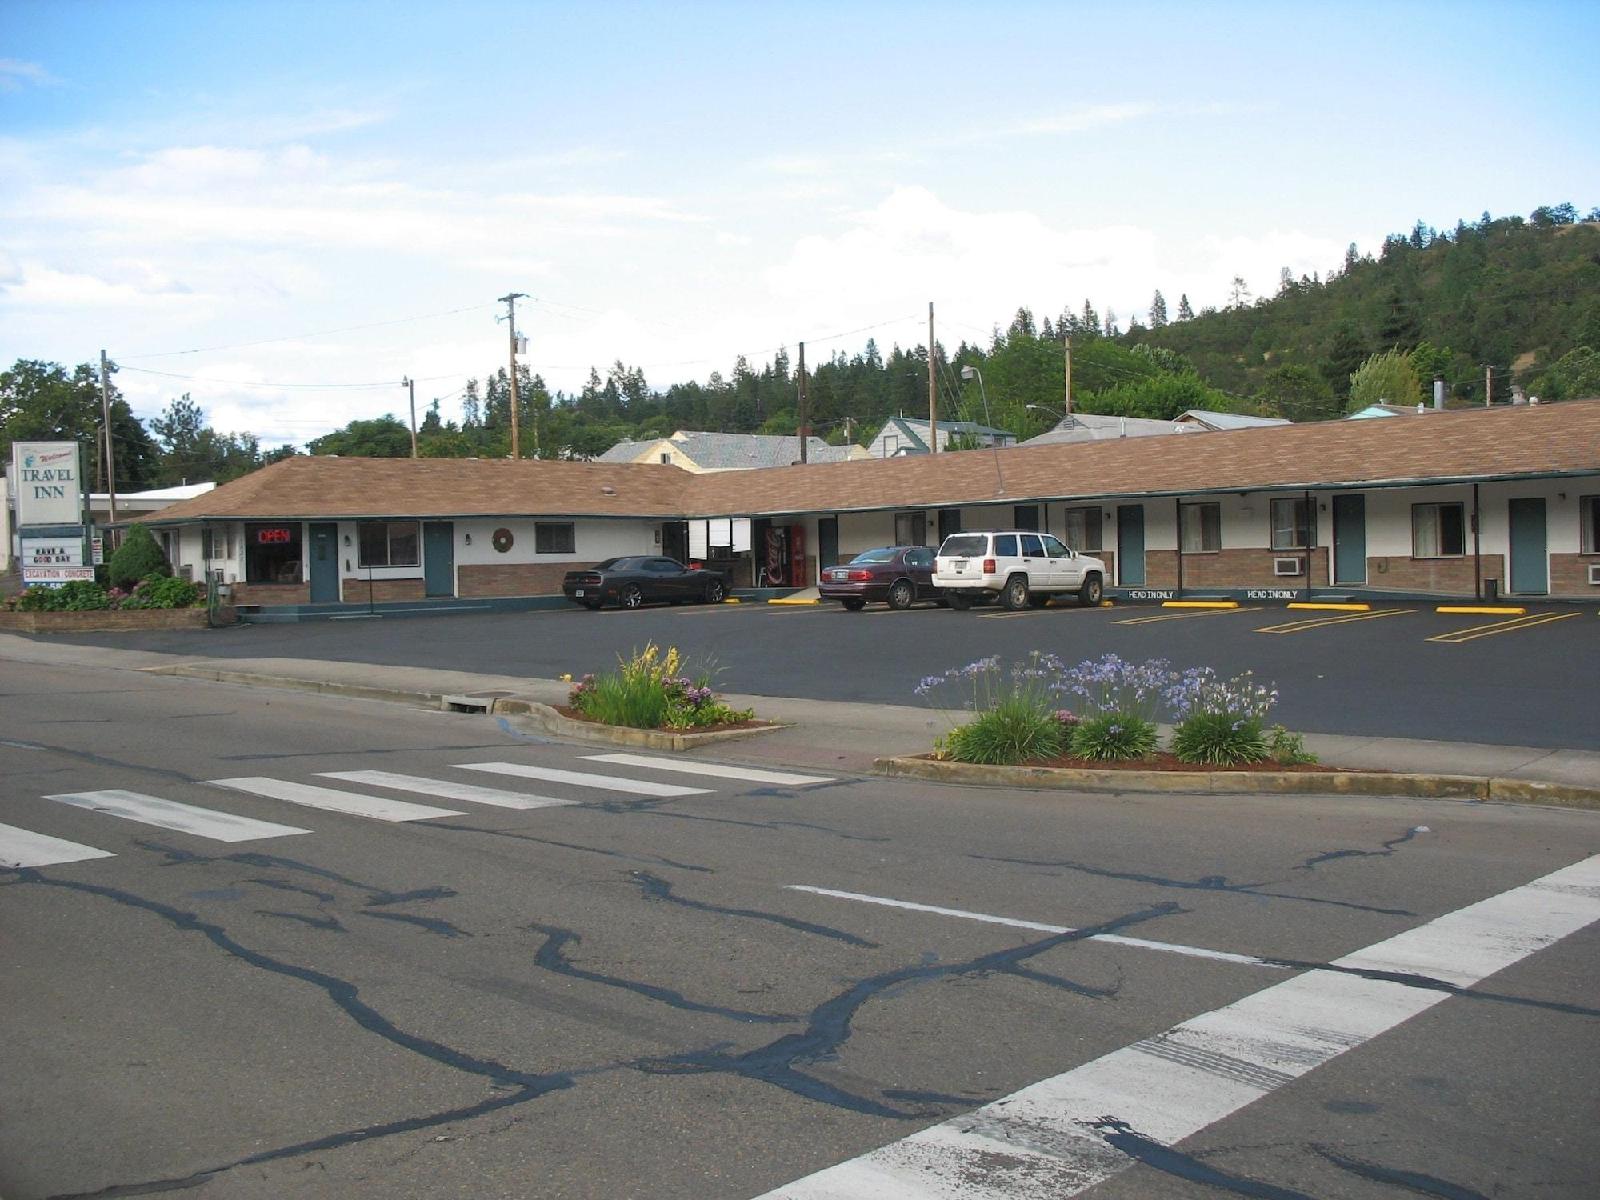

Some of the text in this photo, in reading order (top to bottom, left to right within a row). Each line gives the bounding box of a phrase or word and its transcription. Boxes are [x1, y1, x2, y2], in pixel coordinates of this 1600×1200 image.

[21, 469, 75, 482] TRAVEL
[33, 486, 65, 499] INN
[259, 529, 290, 543] OPEN
[33, 556, 52, 564] GOOD
[25, 569, 94, 578] EXCAVATION CONCRETE
[1128, 590, 1174, 599] HEAD IN ONLY
[1247, 590, 1298, 599] HEAD IN ONLY
